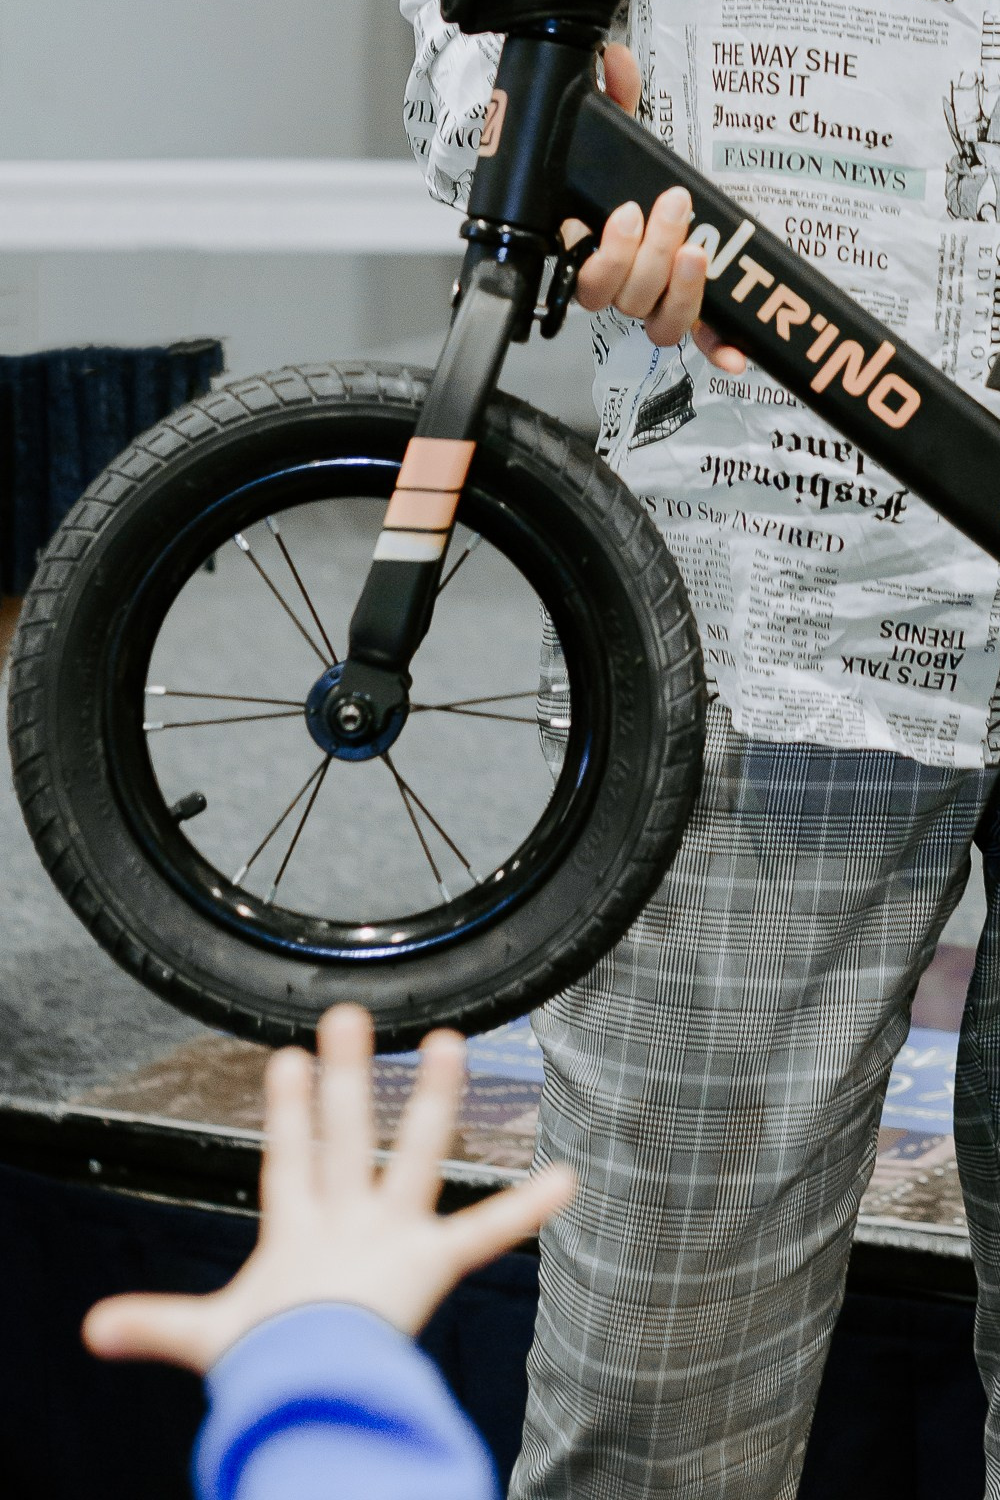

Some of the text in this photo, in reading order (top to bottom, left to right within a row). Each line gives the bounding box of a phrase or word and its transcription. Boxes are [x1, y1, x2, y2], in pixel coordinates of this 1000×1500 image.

[711, 41, 859, 79] THE WAY SHE
[711, 69, 812, 98] WEARS IT
[711, 102, 778, 133] Image
[788, 109, 895, 150] Change
[723, 146, 908, 191] FASHION NEWS
[784, 215, 861, 245] COMFY
[836, 244, 889, 272] CHIC
[771, 430, 866, 476] lance
[699, 454, 910, 525] Fashionable
[661, 497, 845, 555] TO Stay INSPIRED
[878, 618, 968, 651] TRENDS
[839, 654, 958, 693] LET'S TALK
[889, 643, 965, 671] ABOUT
